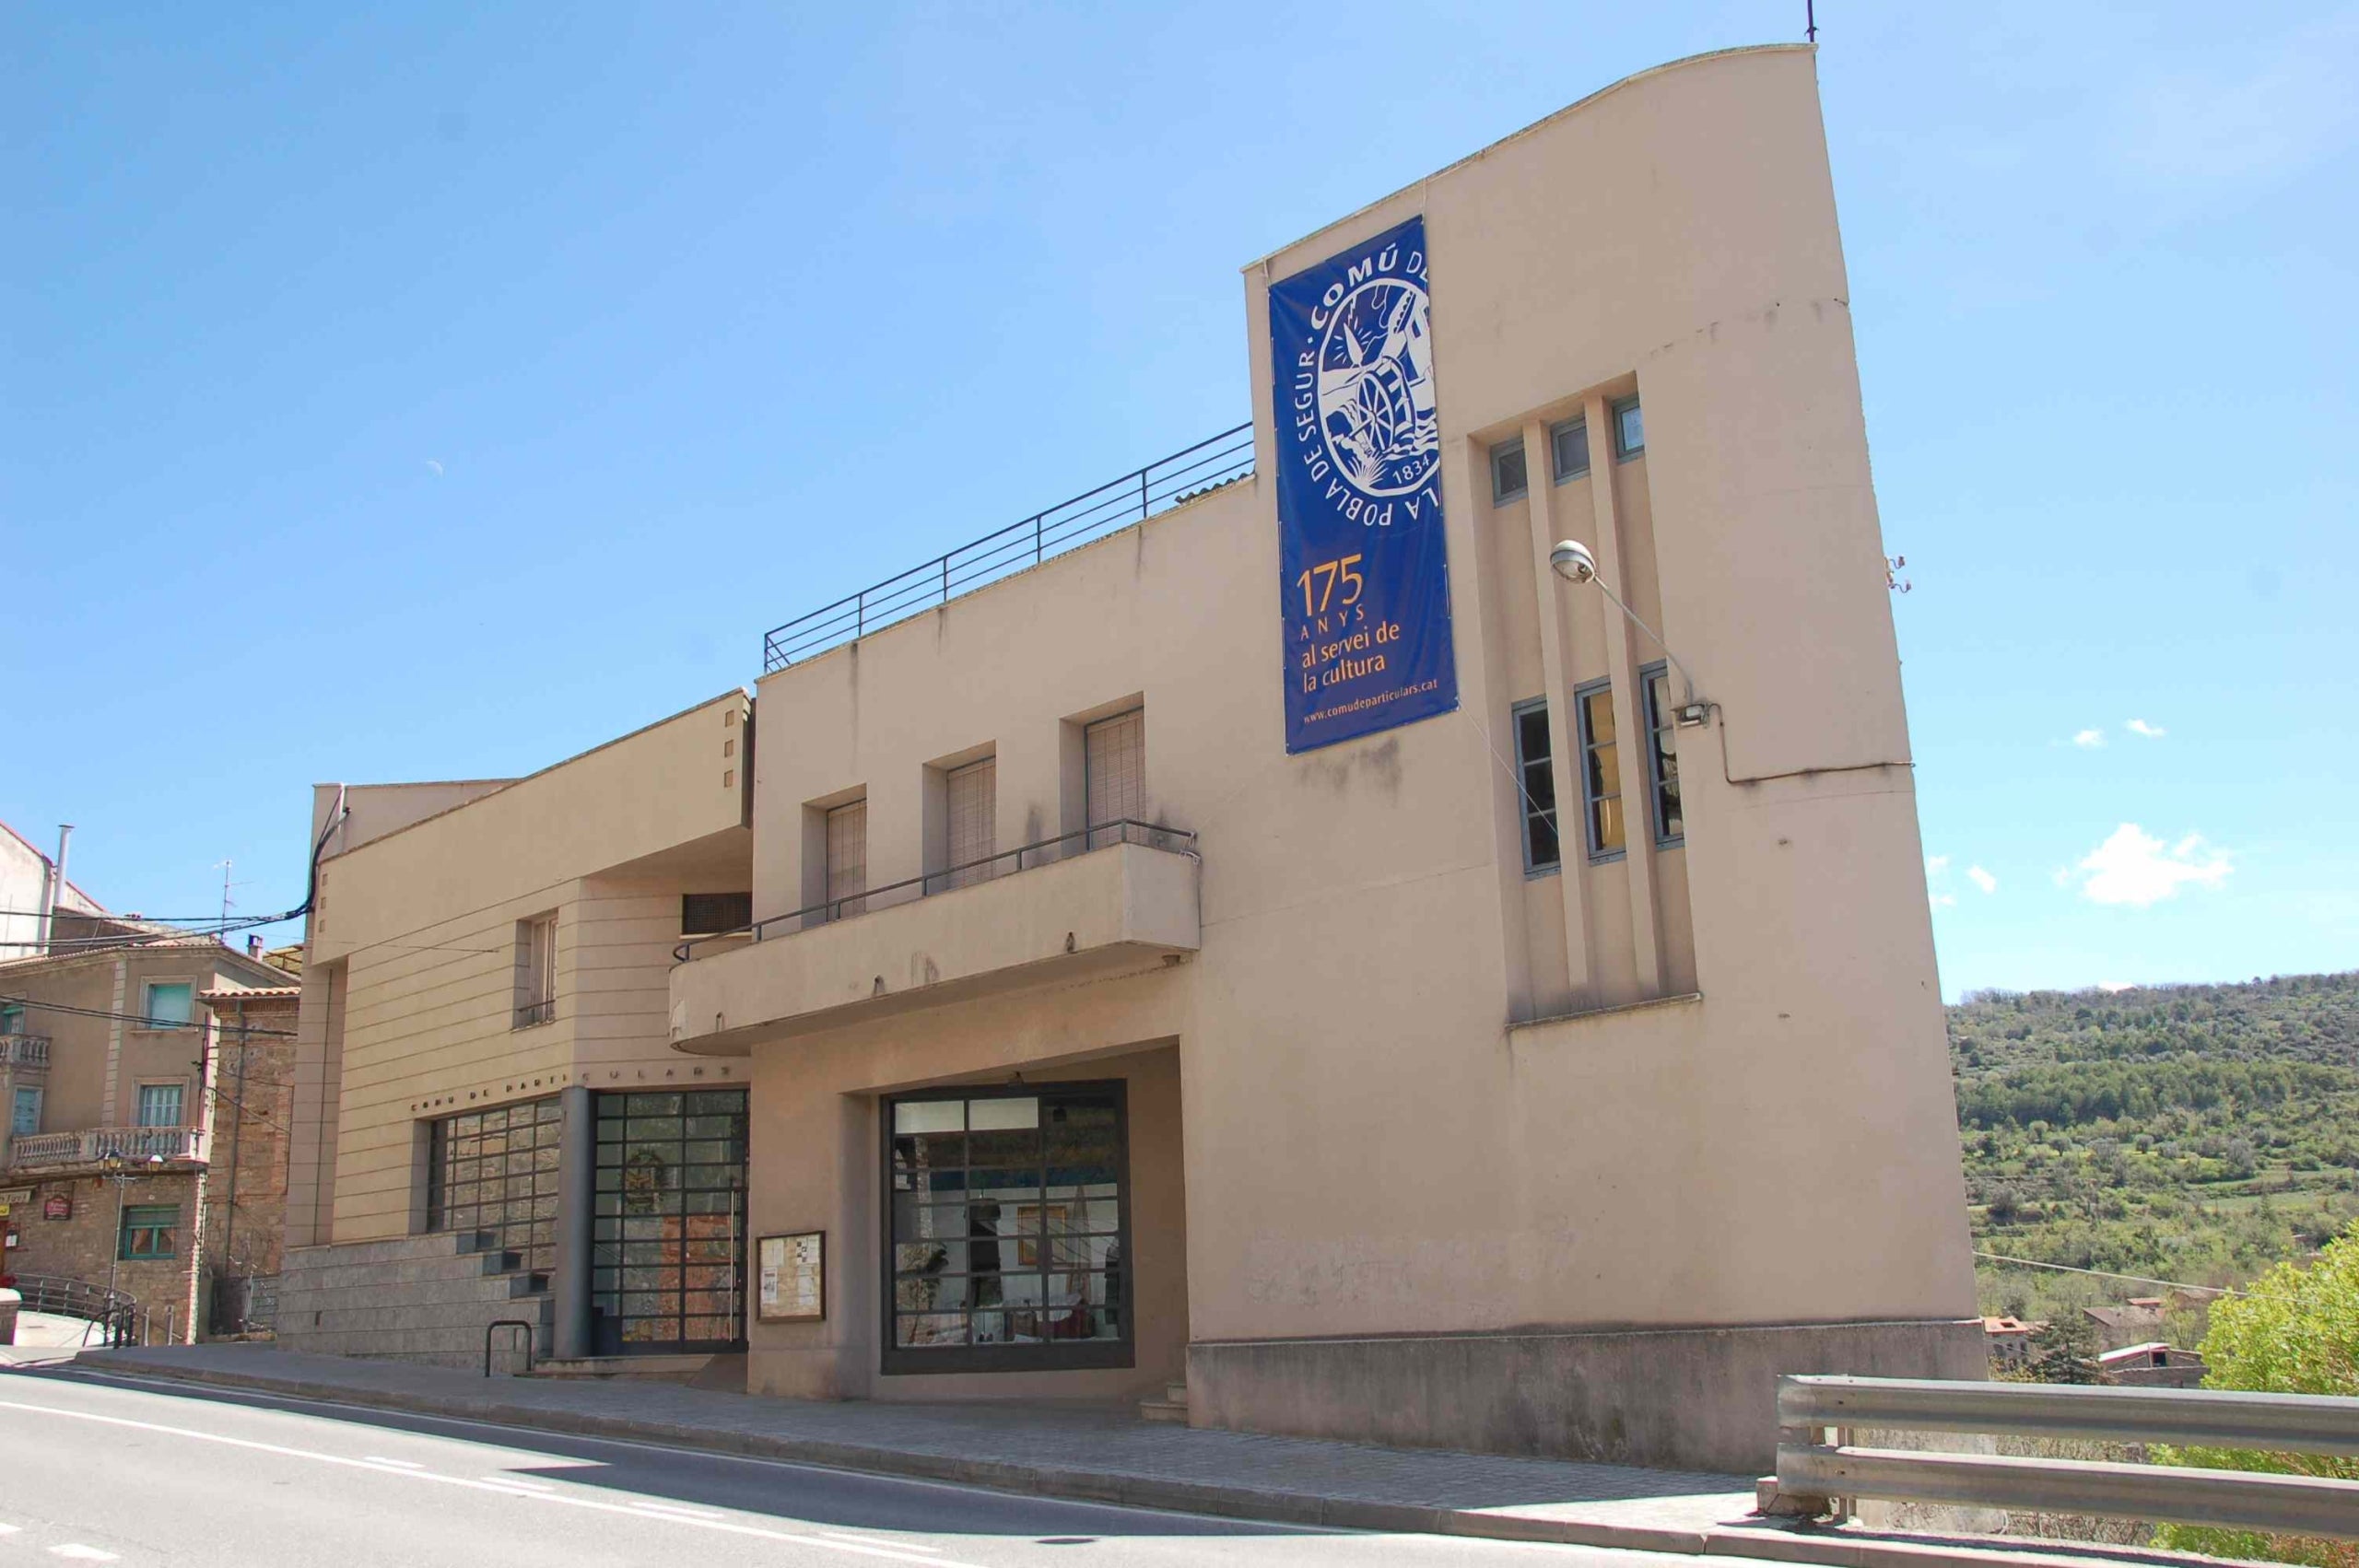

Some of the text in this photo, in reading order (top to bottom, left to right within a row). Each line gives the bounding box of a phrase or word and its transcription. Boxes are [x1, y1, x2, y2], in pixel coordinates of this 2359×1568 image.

[1311, 242, 1398, 330] COMÚ
[1295, 351, 1439, 526] LA POBLA DE SEGUR
[1392, 453, 1429, 485] 1834
[1297, 553, 1363, 616] 175
[1300, 603, 1364, 641] ANYS
[1302, 621, 1400, 669] al servei de
[1303, 654, 1386, 694] la cultura
[1303, 678, 1438, 724] www.comudeparticulars.cat
